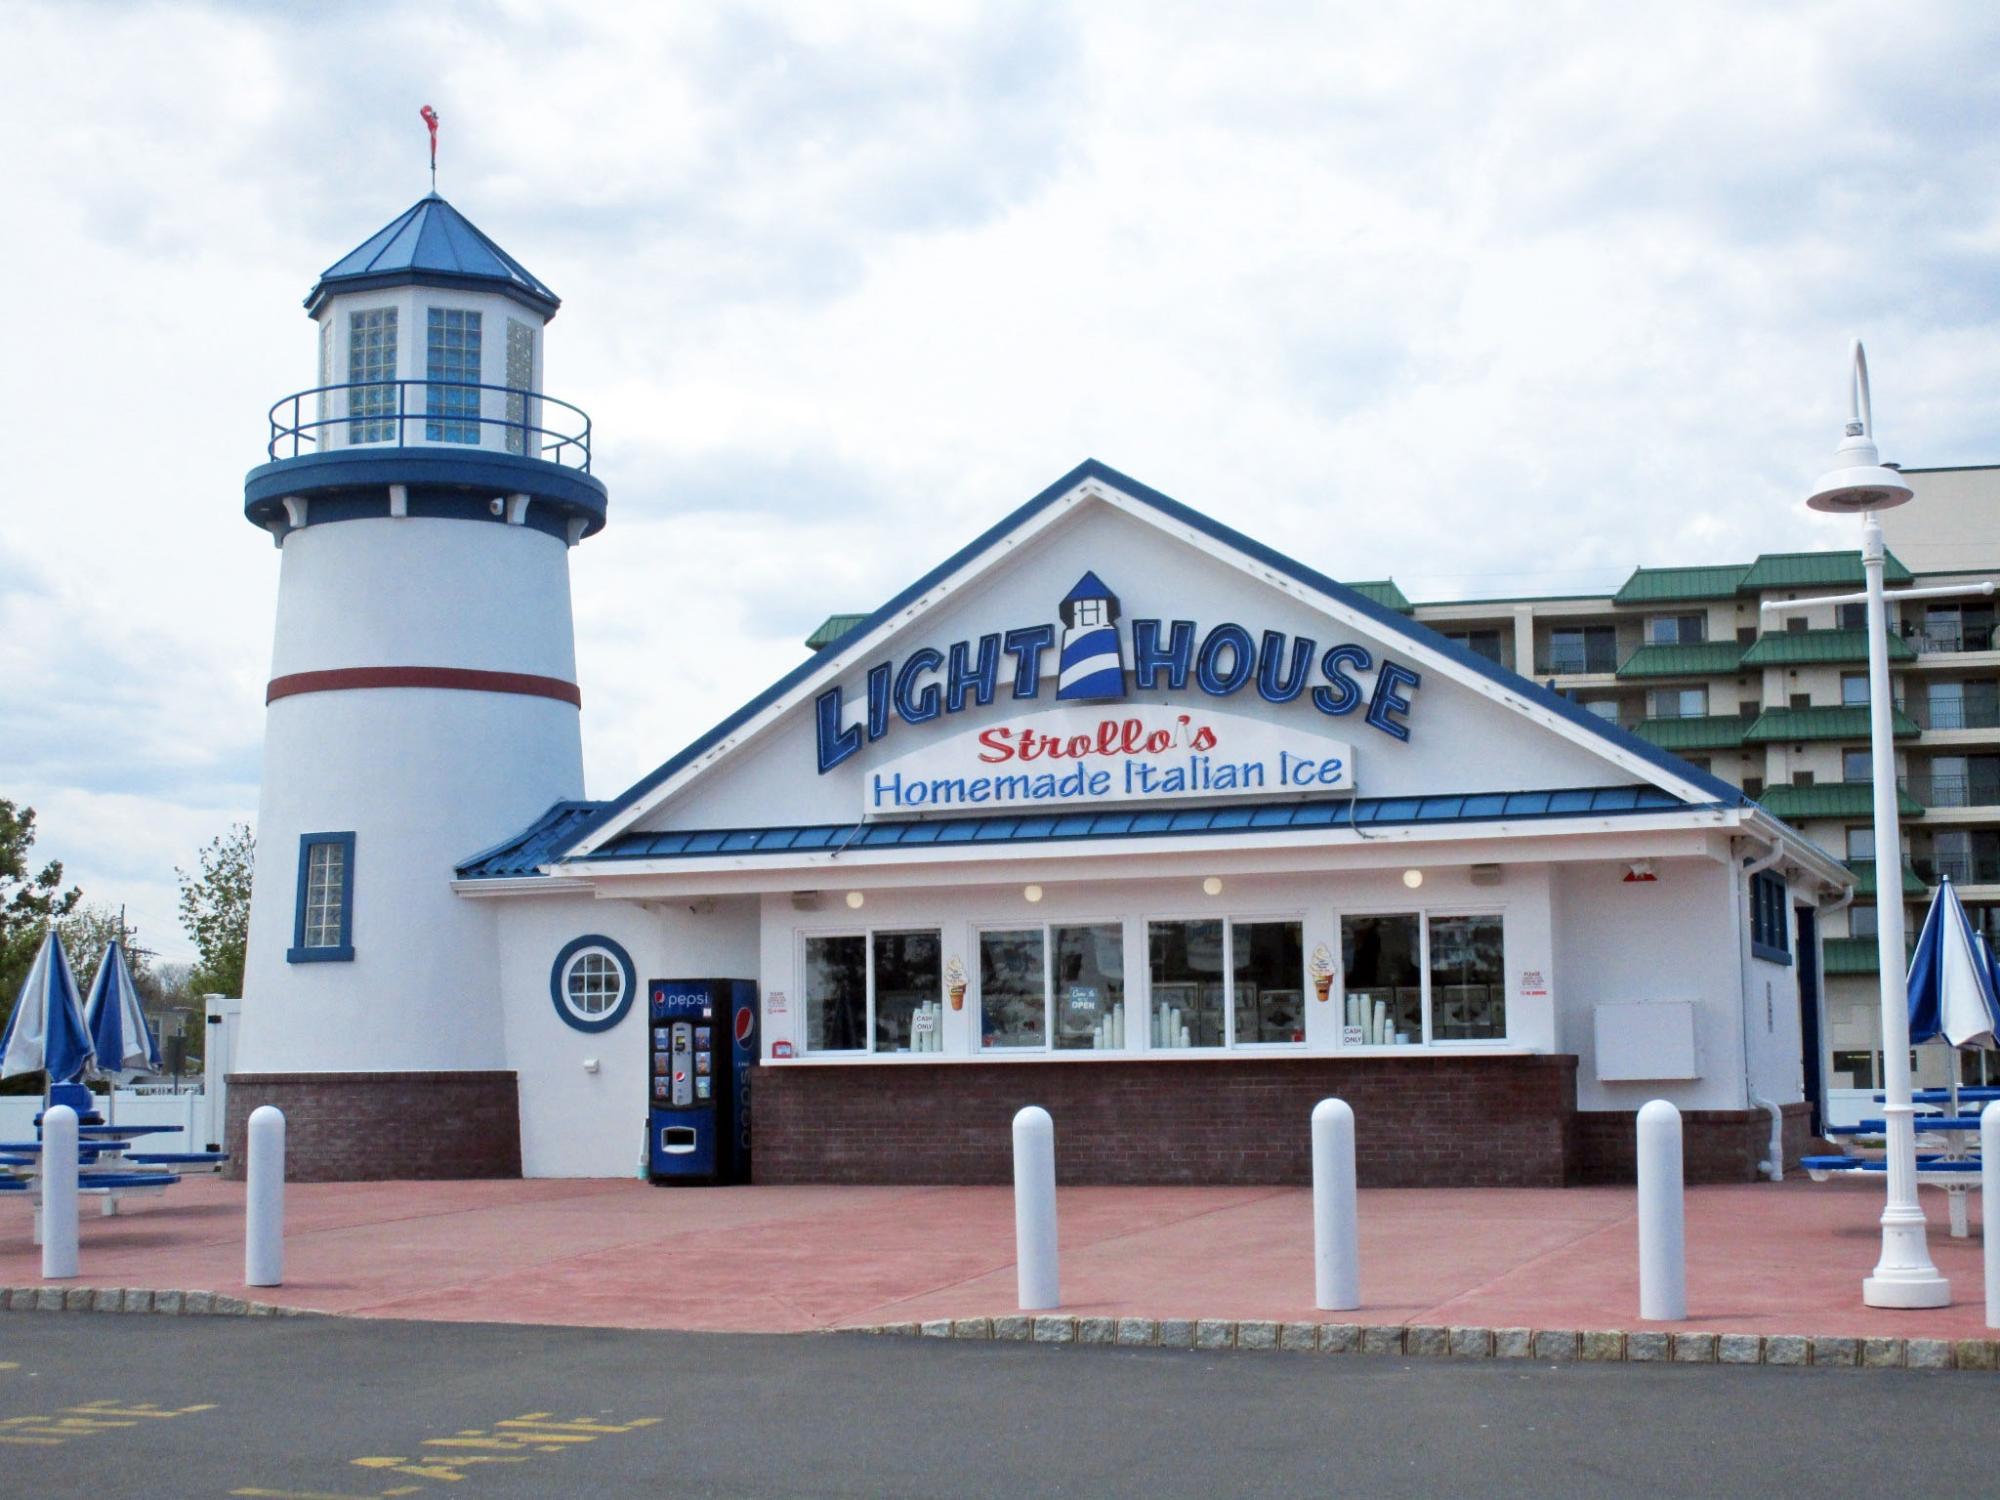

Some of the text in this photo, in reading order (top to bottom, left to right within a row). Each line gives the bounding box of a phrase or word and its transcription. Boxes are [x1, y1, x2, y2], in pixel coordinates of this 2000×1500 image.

[816, 619, 1422, 775] LIGHT HOUSE
[977, 715, 1218, 764] Strollo's
[874, 751, 1342, 807] Homemade Italian Ice
[668, 991, 708, 1008] pepsi
[1072, 1001, 1095, 1010] OPEN
[1344, 1036, 1362, 1044] ONLY
